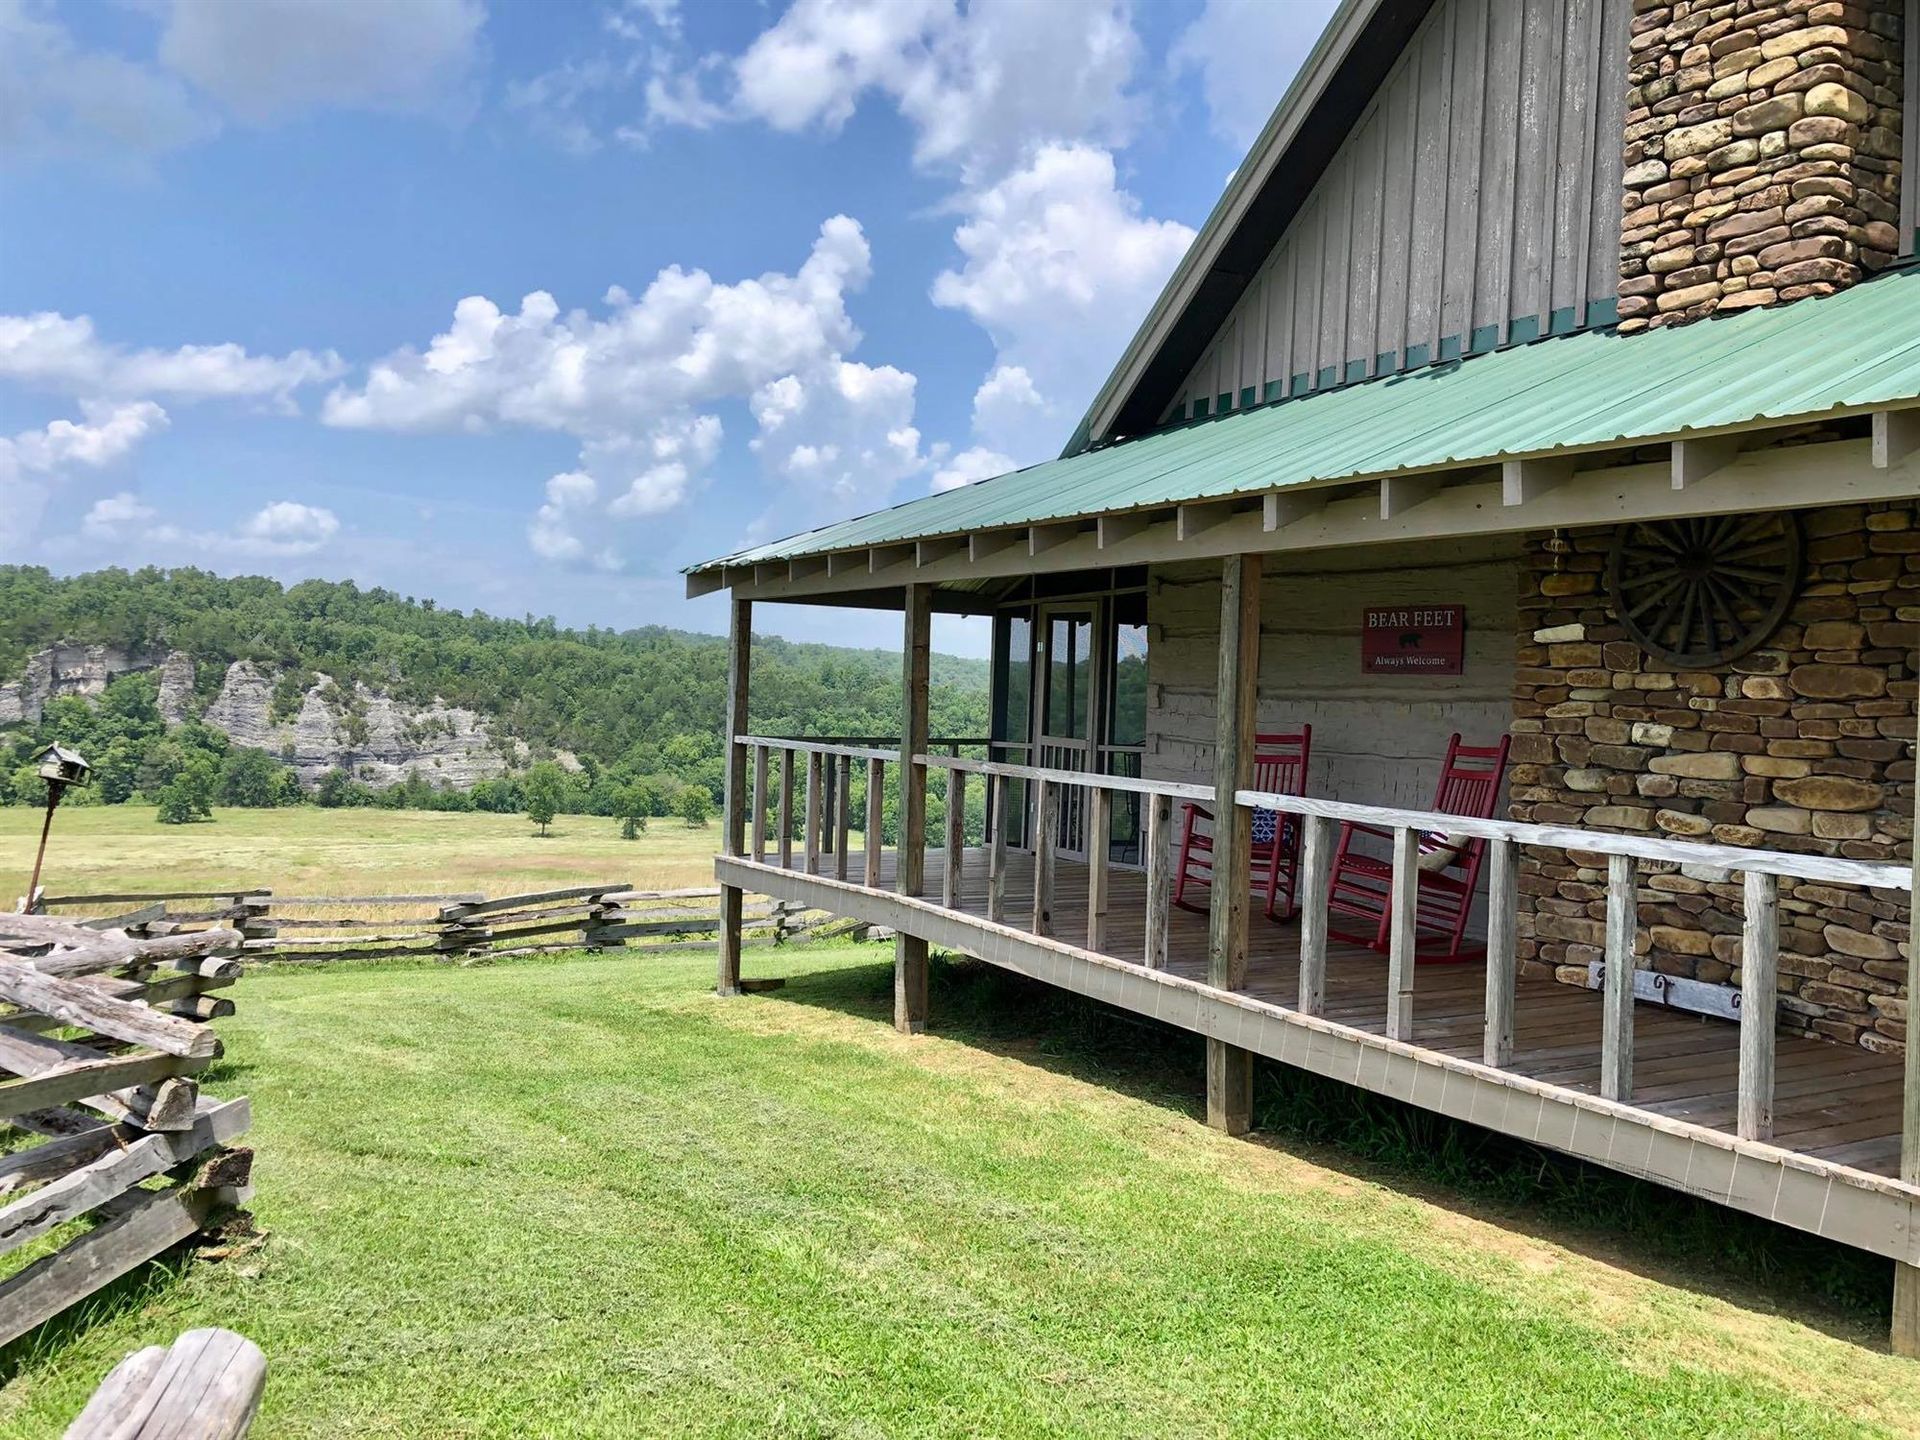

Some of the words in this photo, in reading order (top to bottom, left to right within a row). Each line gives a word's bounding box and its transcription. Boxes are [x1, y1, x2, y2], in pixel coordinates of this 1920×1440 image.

[1369, 612, 1409, 628] BEAR
[1414, 610, 1455, 626] FEET
[1375, 656, 1404, 667] Always
[1406, 656, 1446, 666] Welcome
